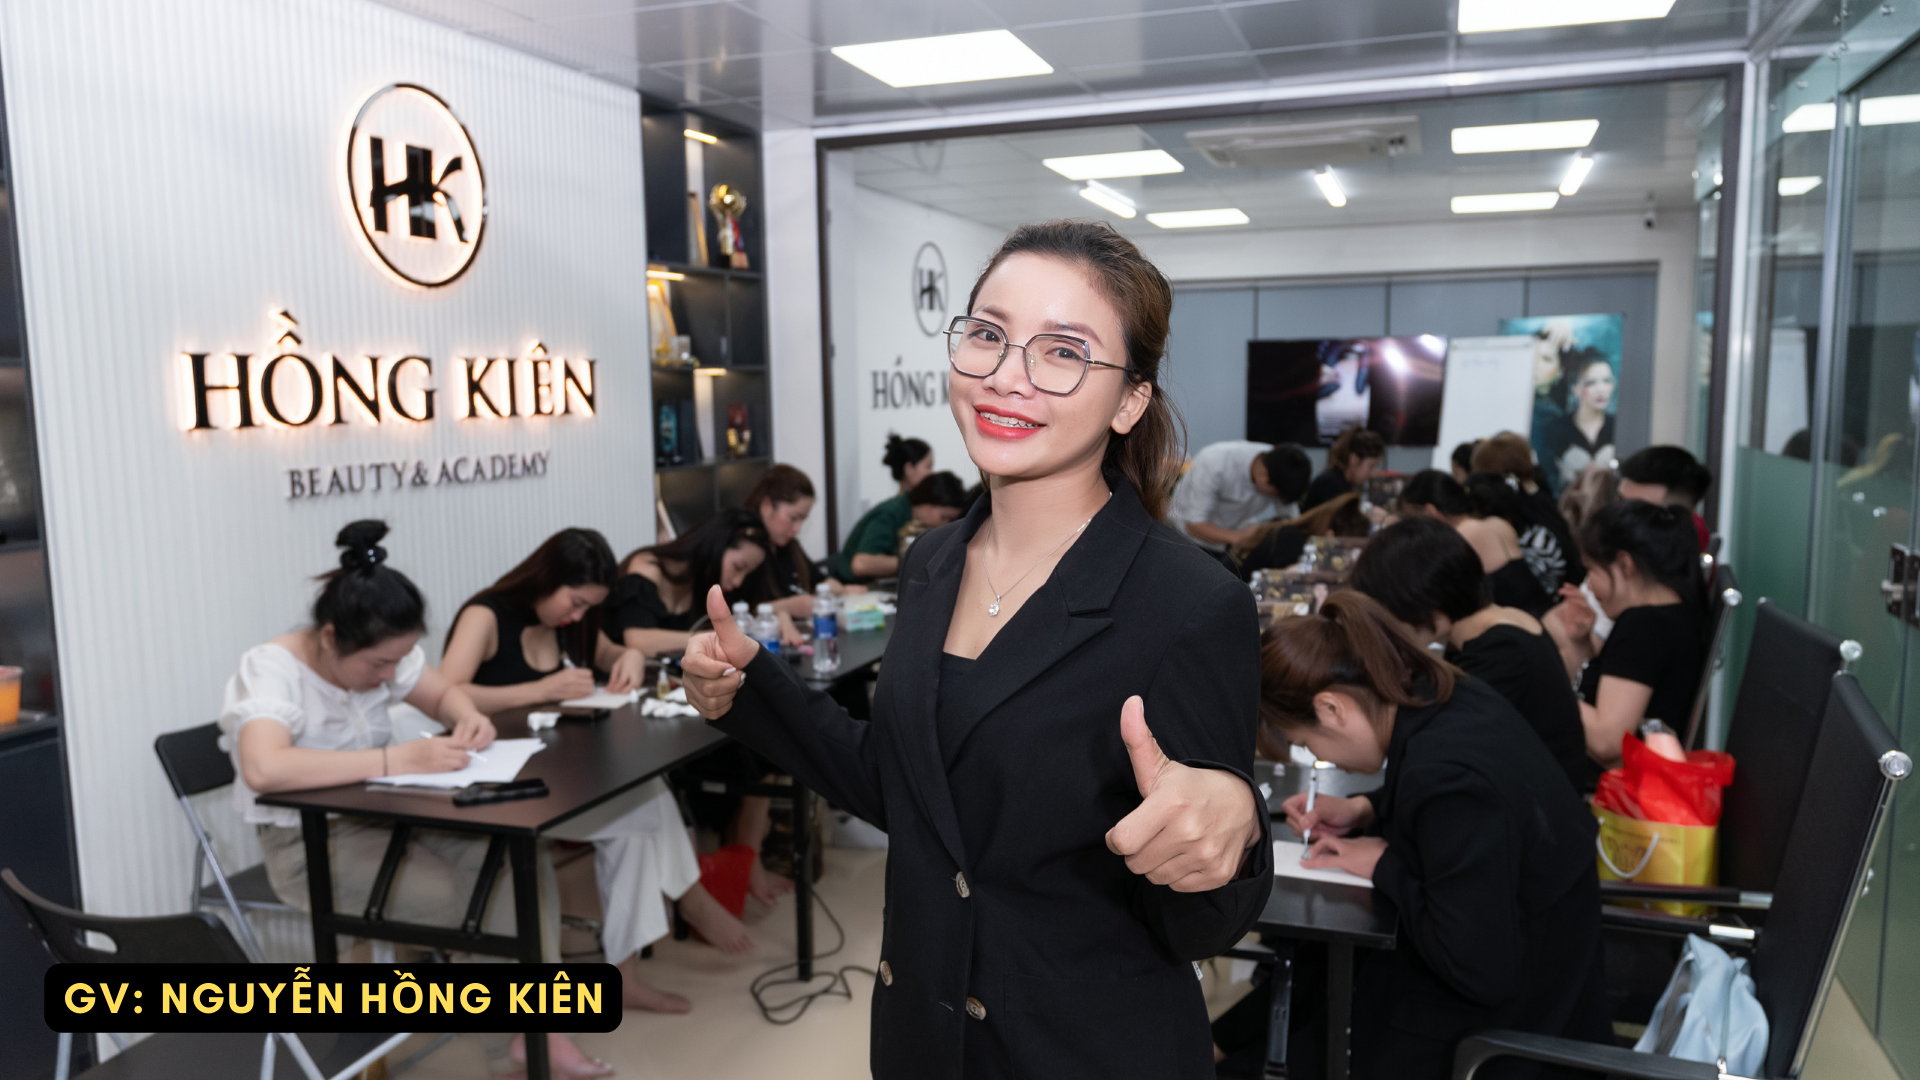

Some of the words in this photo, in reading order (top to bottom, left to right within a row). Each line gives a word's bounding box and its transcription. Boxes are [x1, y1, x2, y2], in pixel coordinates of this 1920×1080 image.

[369, 135, 470, 244] HK
[181, 310, 437, 431] HỒNG
[457, 341, 598, 419] KIÊN
[435, 450, 550, 487] ACADEMY
